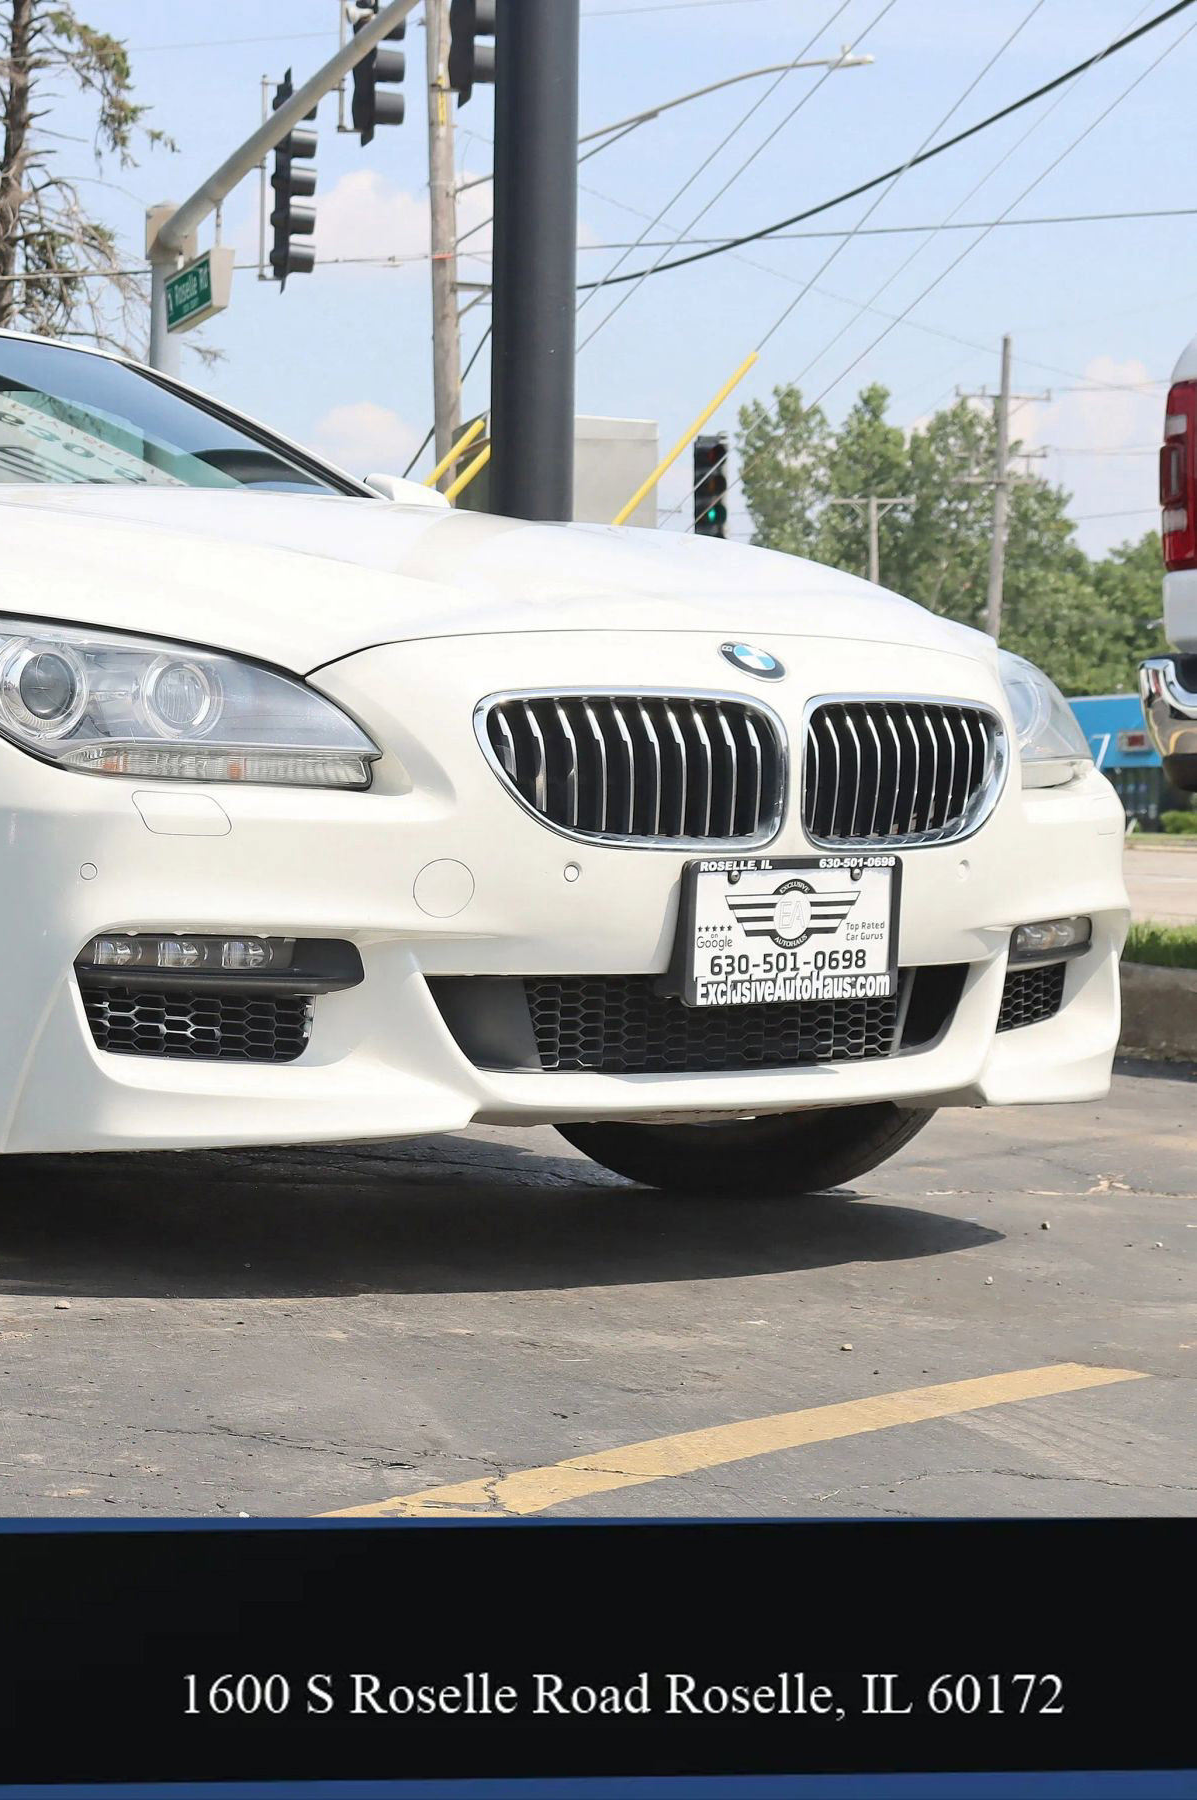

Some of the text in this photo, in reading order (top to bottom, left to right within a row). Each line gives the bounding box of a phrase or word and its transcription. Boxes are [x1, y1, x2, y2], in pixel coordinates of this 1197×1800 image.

[700, 859, 773, 872] ROSELLE, IL
[819, 857, 896, 868] 630-501-0698
[779, 881, 810, 894] EXCLUSIVE
[779, 901, 806, 929] EA
[846, 921, 885, 931] Top Rated
[774, 934, 808, 947] AUTOHAUS
[846, 931, 884, 941] Car Gurus
[696, 936, 733, 951] Google
[710, 949, 867, 976] 630-501-0698
[696, 971, 890, 1005] ExclusiveAutoHaus.com
